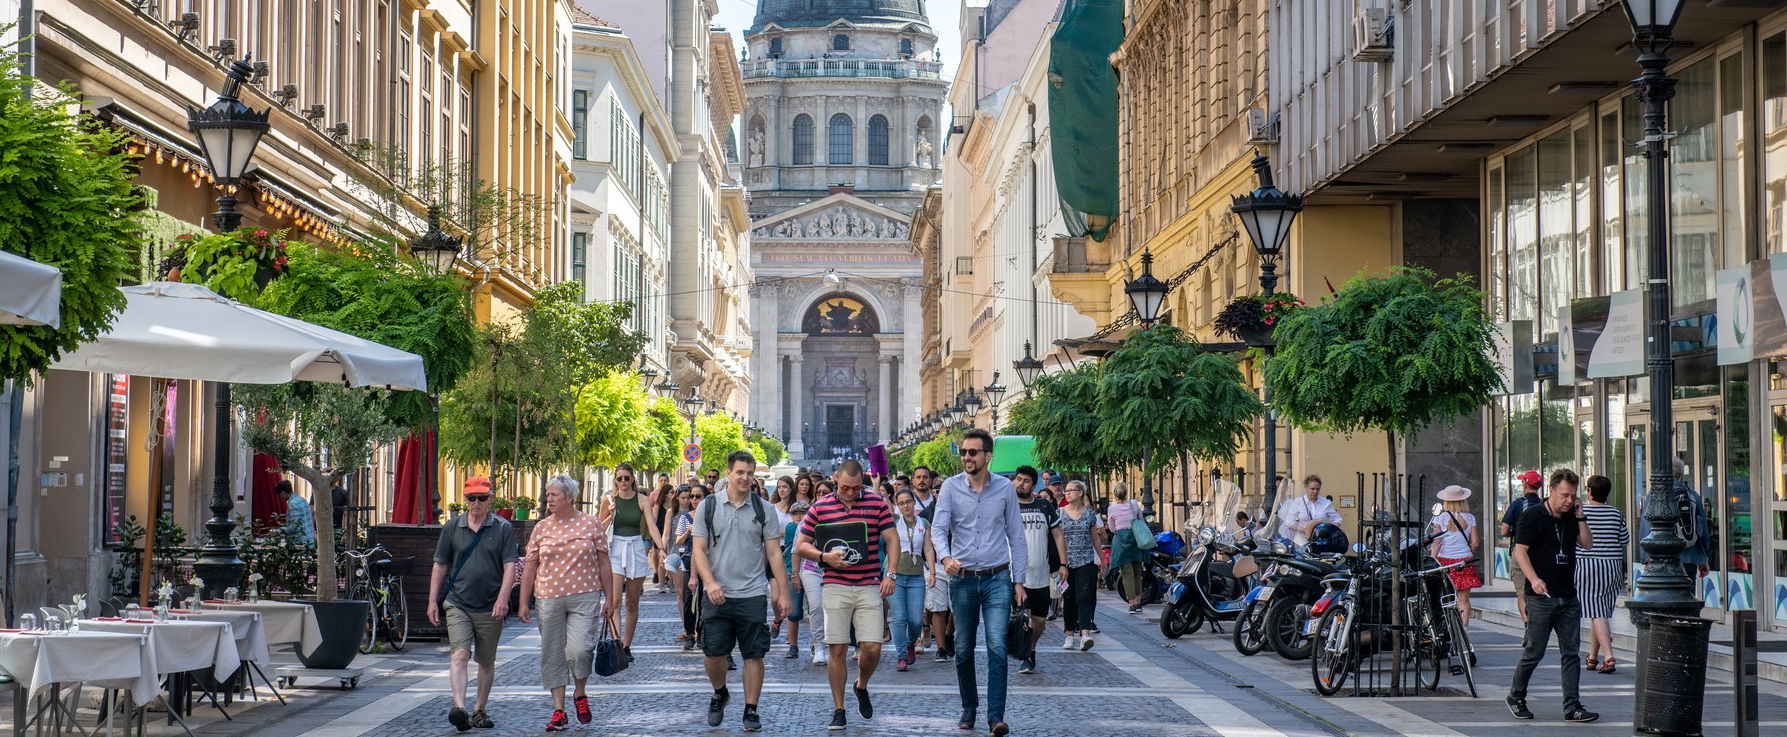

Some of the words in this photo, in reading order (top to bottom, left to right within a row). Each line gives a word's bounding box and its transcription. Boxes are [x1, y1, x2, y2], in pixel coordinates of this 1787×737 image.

[794, 254, 812, 262] SUM
[818, 254, 834, 262] VIA
[839, 254, 872, 262] VERITAS
[893, 254, 911, 262] VITA
